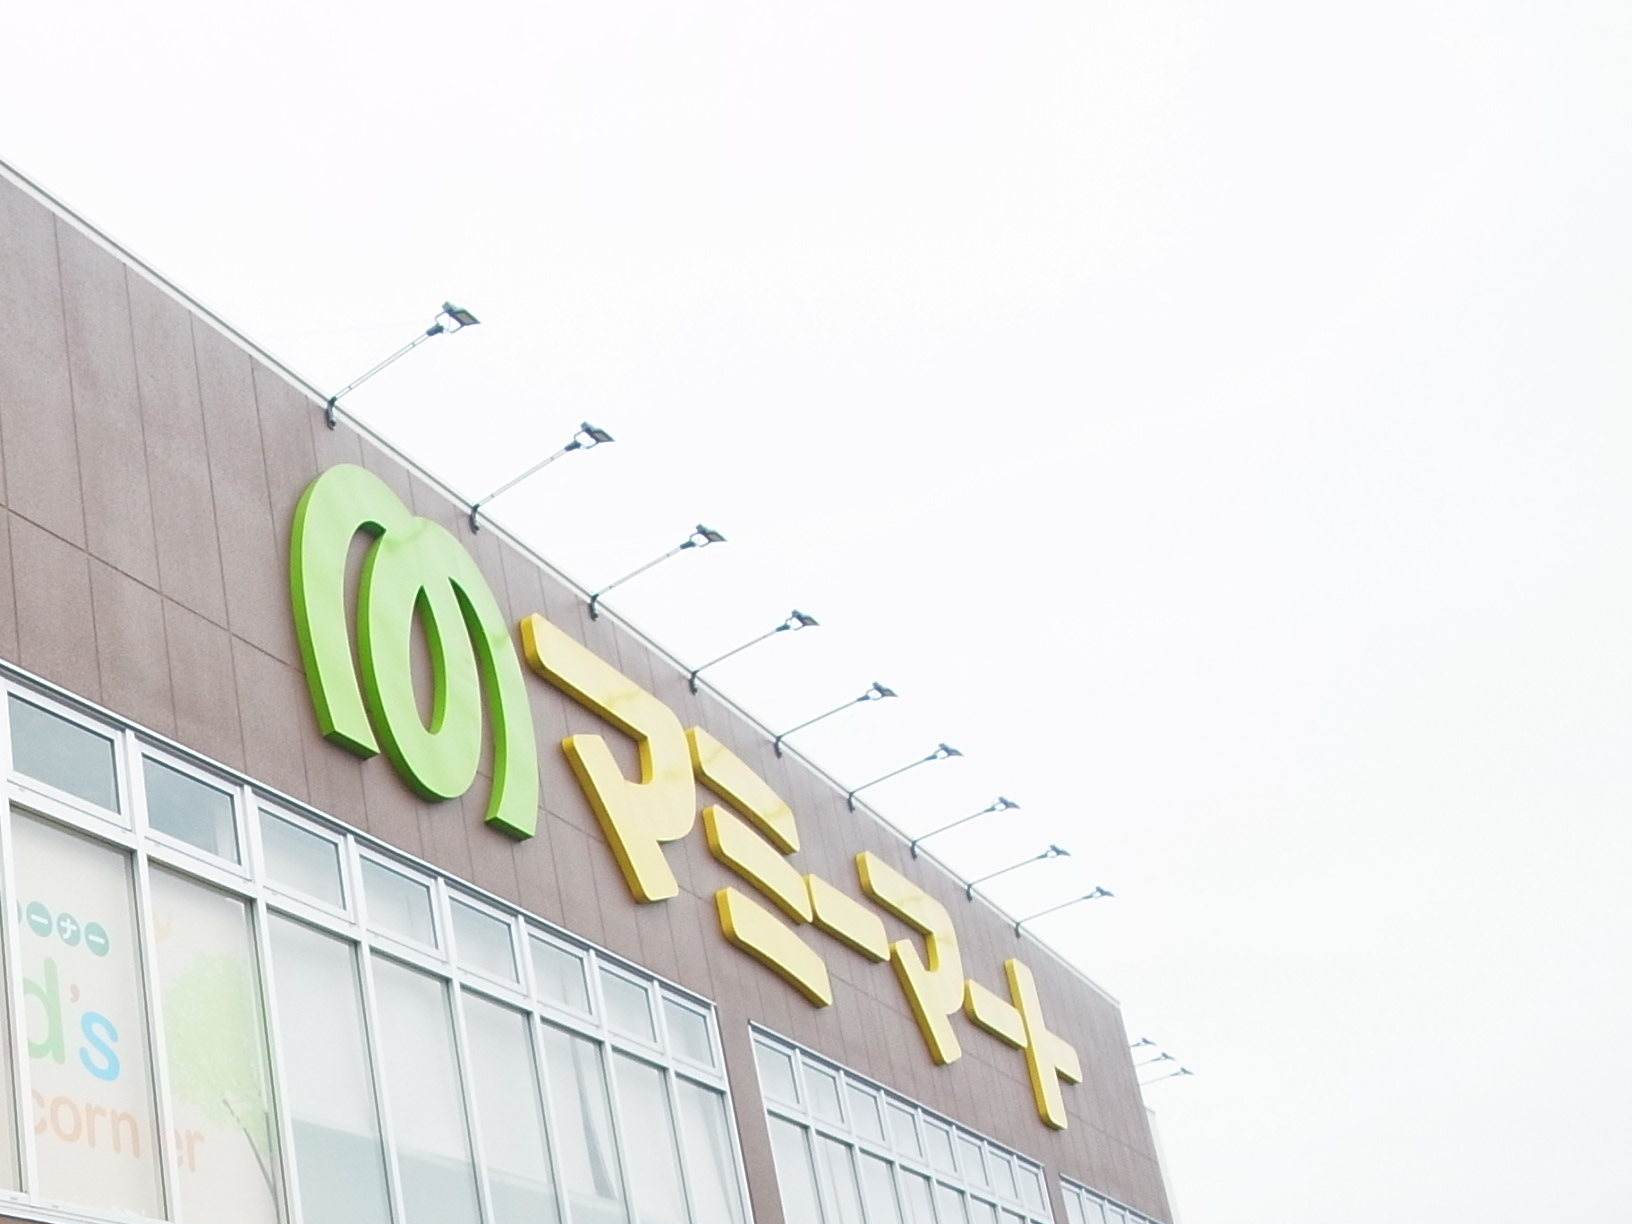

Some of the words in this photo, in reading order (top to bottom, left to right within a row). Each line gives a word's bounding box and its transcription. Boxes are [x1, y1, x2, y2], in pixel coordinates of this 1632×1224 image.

[16, 900, 110, 957] ーナー
[520, 612, 1083, 1131] マミーマート
